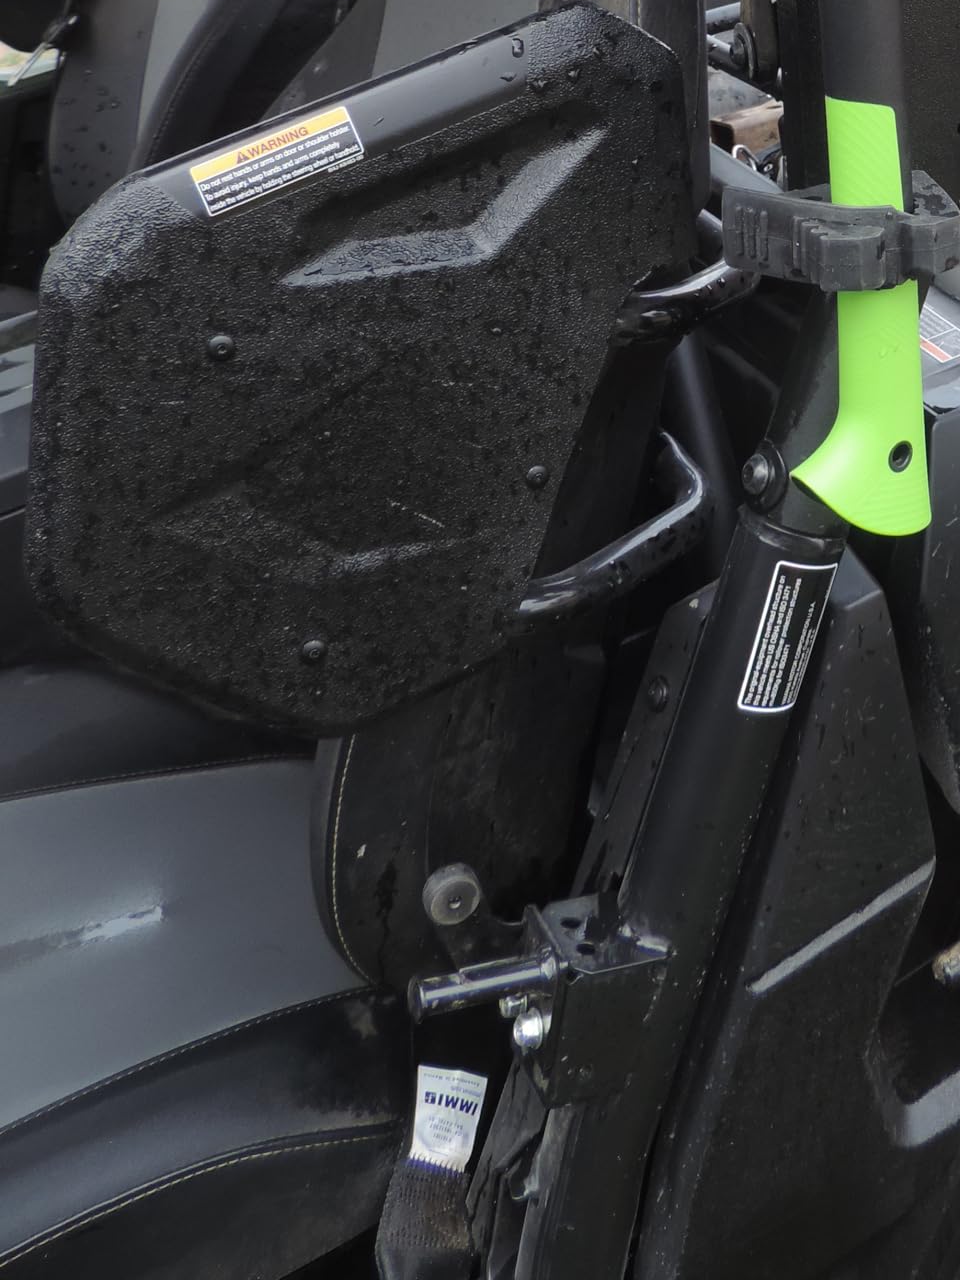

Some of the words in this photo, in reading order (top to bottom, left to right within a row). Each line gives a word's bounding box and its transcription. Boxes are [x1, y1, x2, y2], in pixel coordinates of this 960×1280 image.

[200, 183, 211, 191] Do
[210, 178, 222, 187] not
[221, 173, 234, 183] rest
[232, 166, 253, 177] hands
[259, 157, 275, 167] arms
[283, 146, 297, 157] door
[304, 133, 329, 148] shoulder
[247, 126, 309, 158] WARNING
[204, 193, 214, 201] To
[213, 185, 231, 198] avoid
[247, 173, 264, 184] keep
[262, 165, 282, 177] hands
[281, 159, 294, 169] and
[293, 154, 309, 164] arms
[308, 141, 340, 159] completely
[209, 200, 227, 212] inside
[225, 196, 236, 205] the
[235, 188, 255, 201] vehicle
[254, 185, 263, 193] by
[261, 176, 283, 190] holding
[281, 173, 292, 181] the
[291, 164, 314, 178] steering
[312, 156, 329, 168] wheel
[437, 1093, 478, 1115] IMMI
